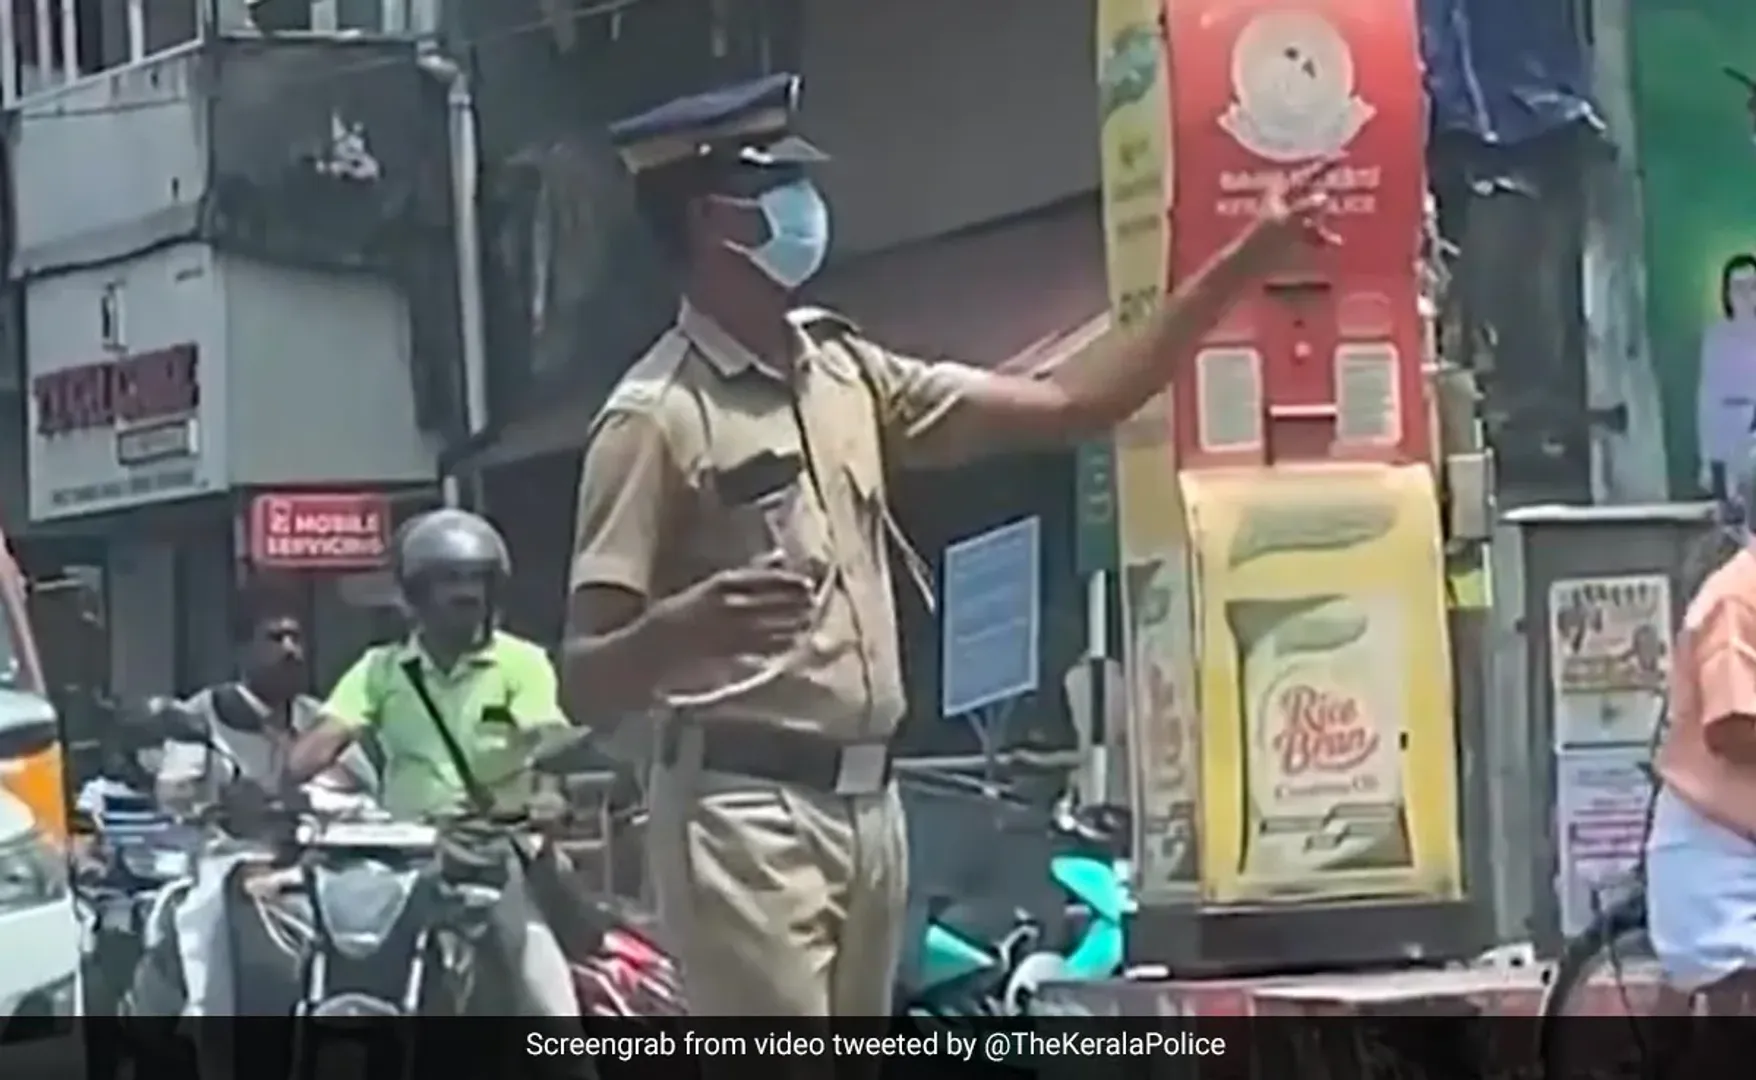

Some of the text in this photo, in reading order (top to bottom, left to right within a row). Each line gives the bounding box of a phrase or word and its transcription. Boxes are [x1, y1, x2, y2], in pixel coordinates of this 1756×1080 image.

[295, 513, 380, 534] MOBILE
[267, 537, 384, 556] SERVICING
[1279, 684, 1359, 733] Rice
[1272, 728, 1381, 776] Bran
